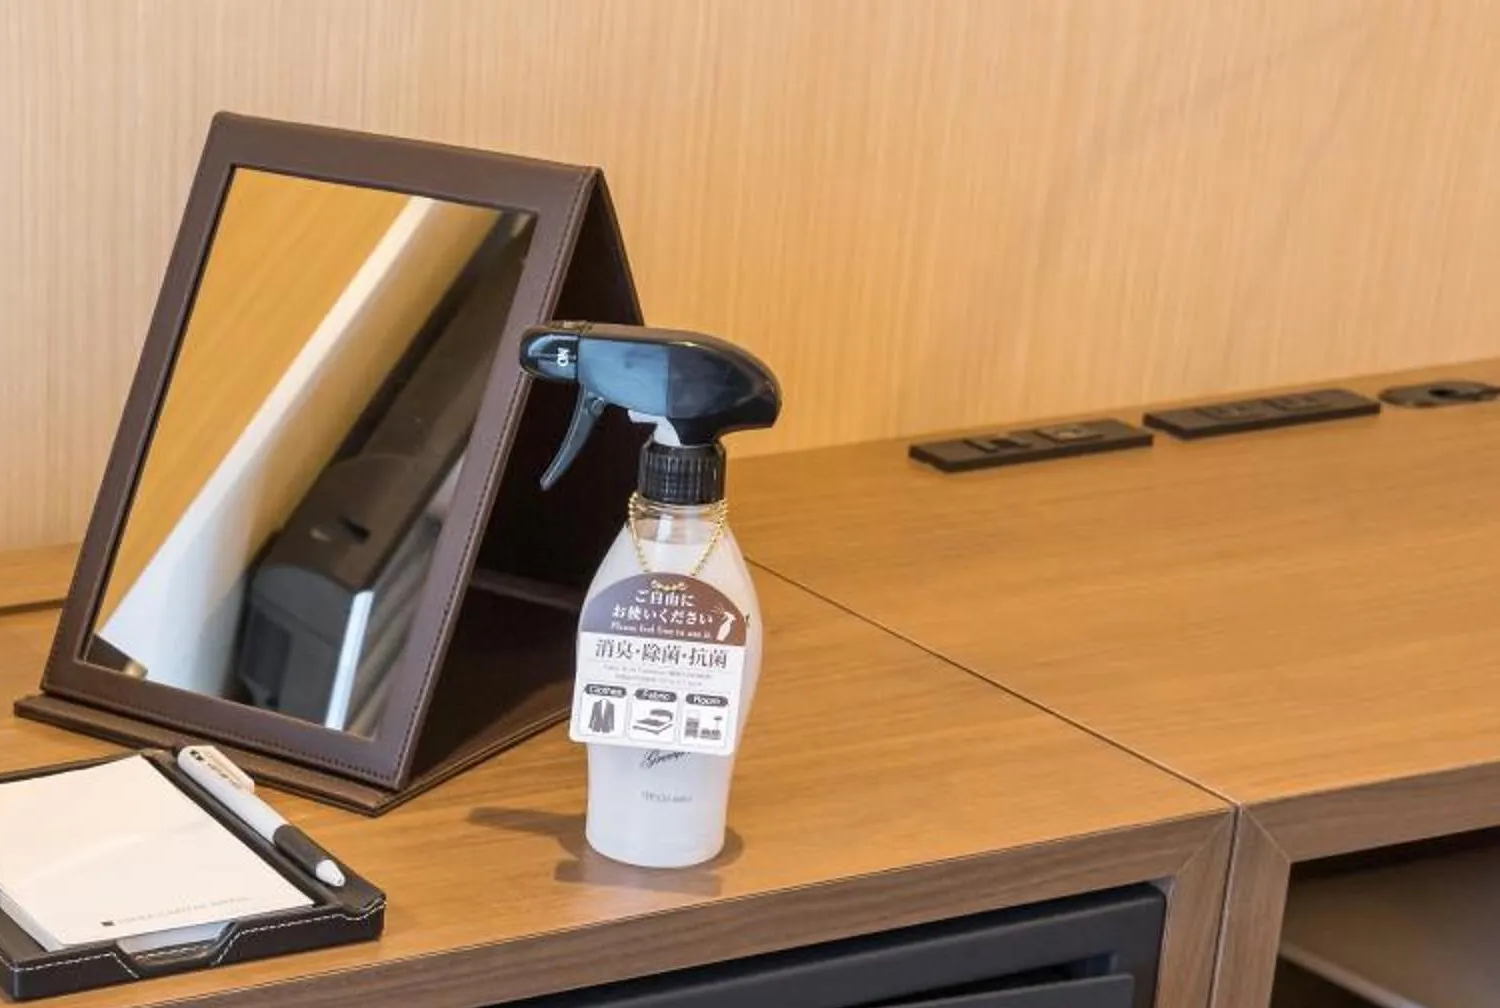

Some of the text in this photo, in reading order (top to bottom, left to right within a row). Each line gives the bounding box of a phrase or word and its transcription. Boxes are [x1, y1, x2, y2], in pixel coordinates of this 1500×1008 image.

[635, 589, 696, 607] ご自由に
[611, 604, 713, 625] お使いください
